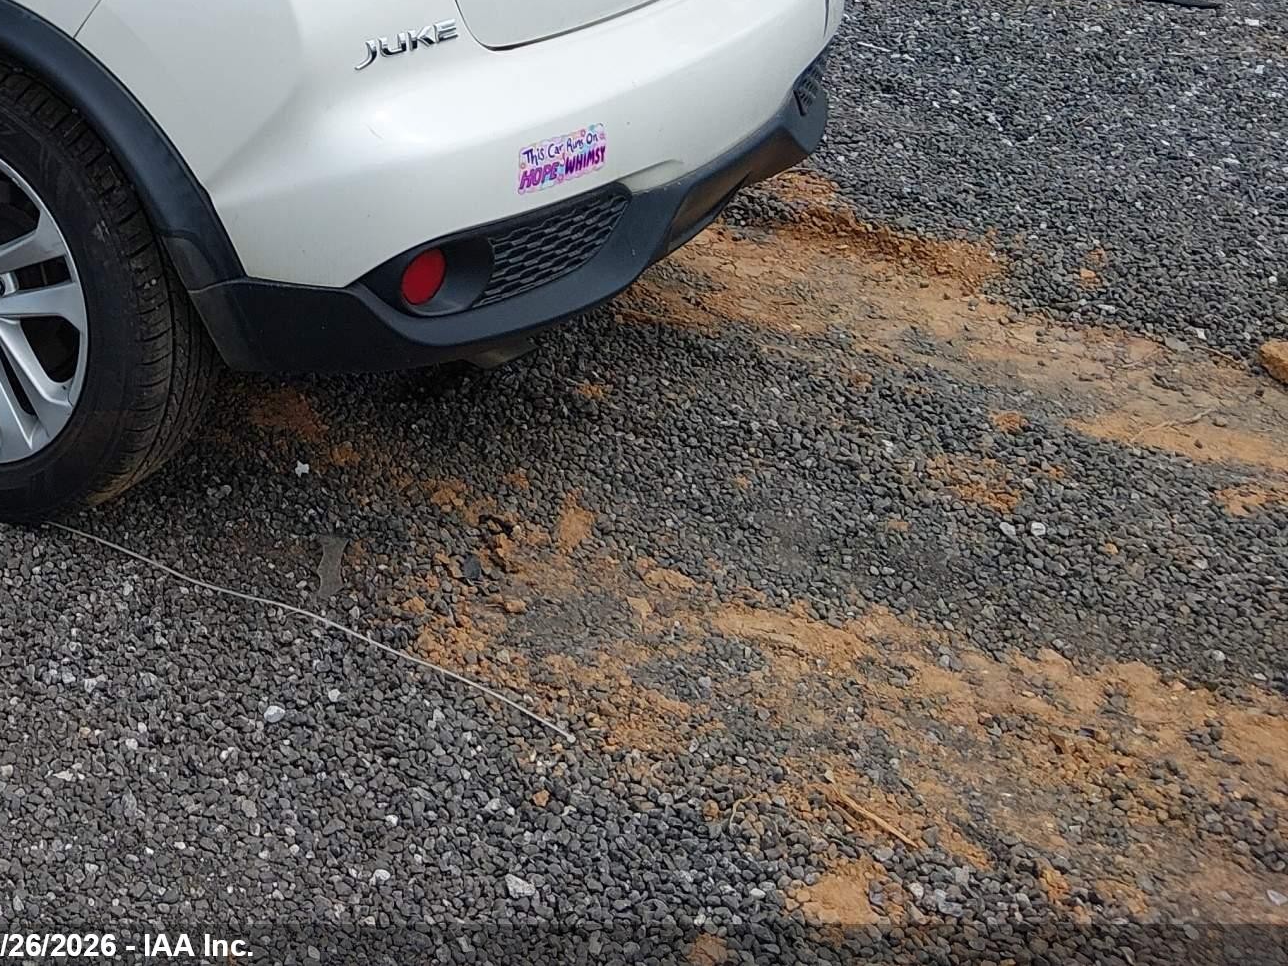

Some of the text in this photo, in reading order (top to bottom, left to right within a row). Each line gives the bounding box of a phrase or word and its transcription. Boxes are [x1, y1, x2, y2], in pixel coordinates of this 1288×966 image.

[354, 18, 459, 71] JUKE
[519, 146, 606, 190] HOPE WHIMSY
[522, 133, 598, 166] This Car Runs On
